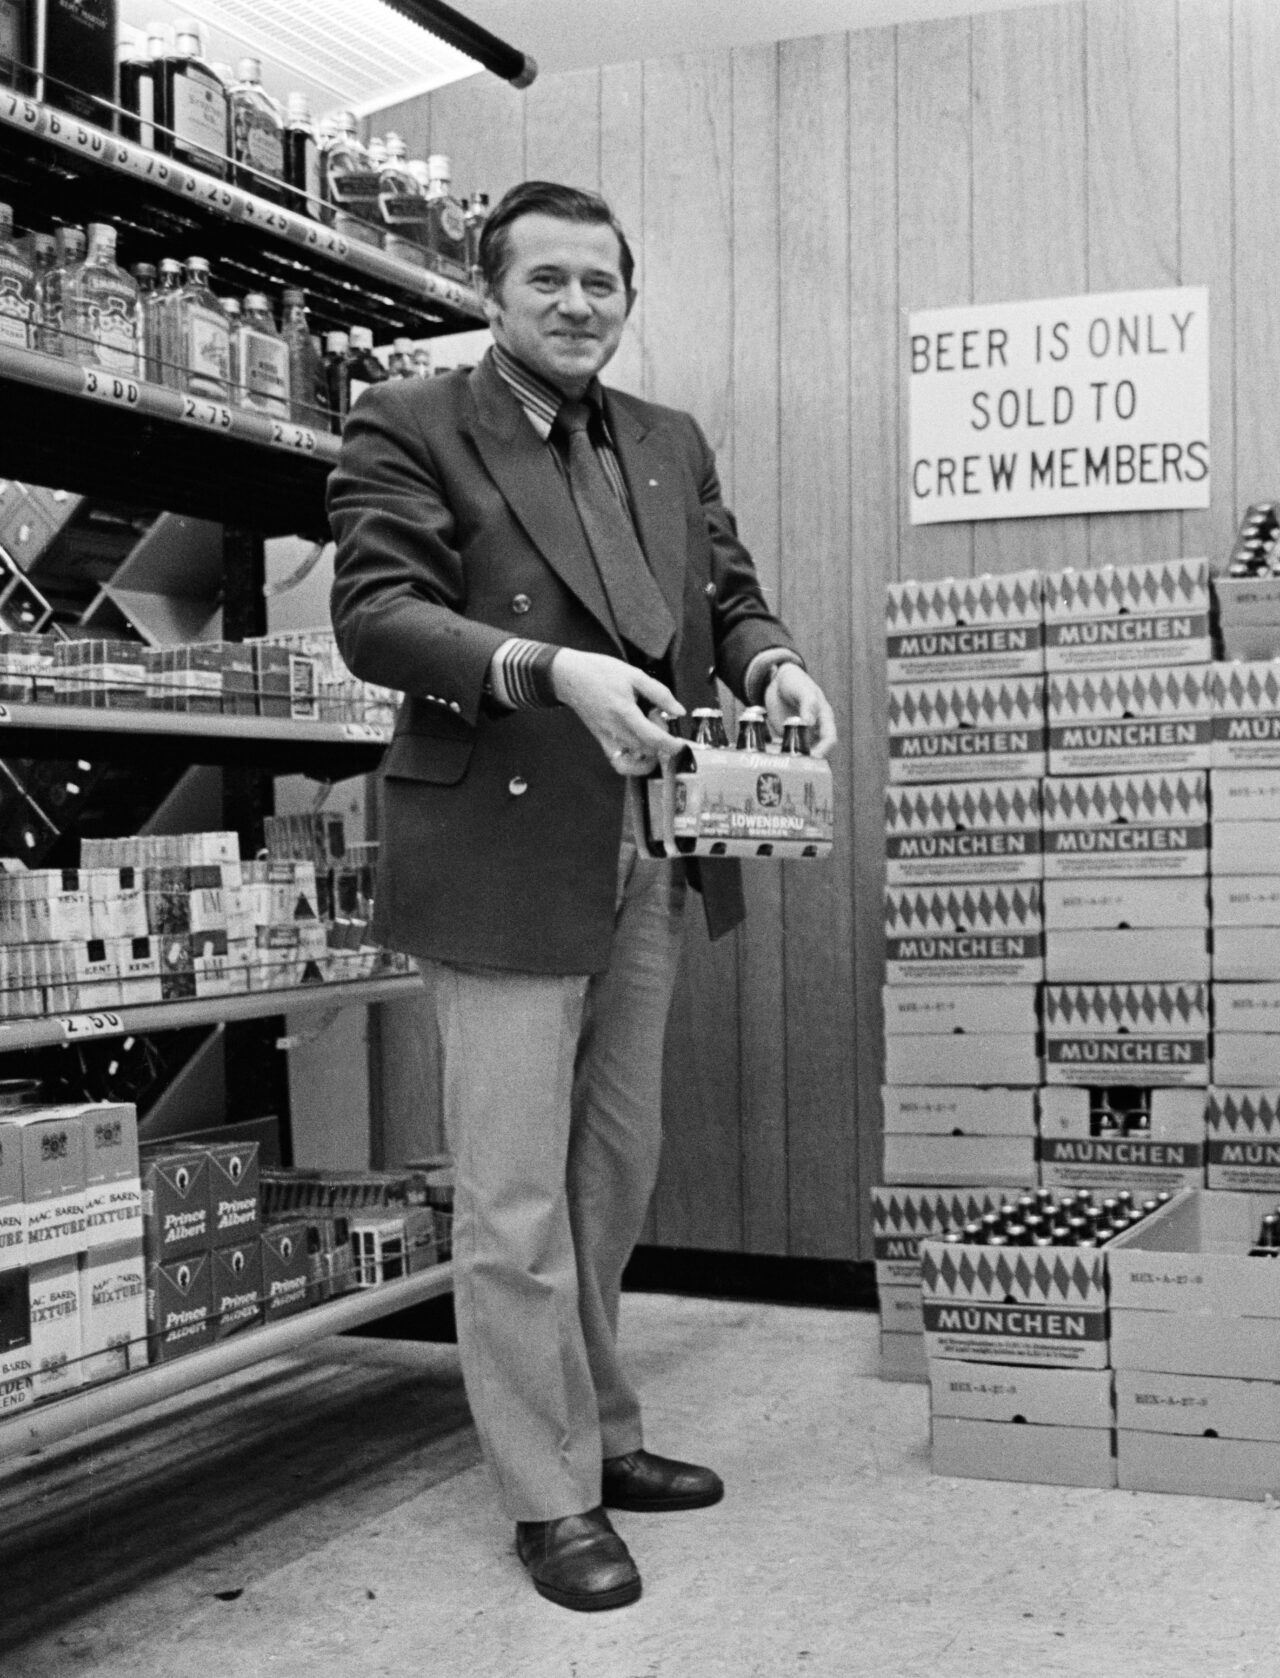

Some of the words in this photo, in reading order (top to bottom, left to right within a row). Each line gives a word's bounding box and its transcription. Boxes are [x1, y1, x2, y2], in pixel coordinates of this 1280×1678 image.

[911, 328, 1008, 374] BEER
[1036, 321, 1070, 364] IS
[1088, 311, 1195, 358] ONLY
[185, 399, 231, 427] 2.75
[970, 386, 1074, 431] SOLD
[1090, 380, 1137, 423] TO
[912, 452, 1018, 499] CREW
[1030, 440, 1209, 491] MEMBERS
[899, 630, 1027, 656] MÜNCHEN
[1058, 618, 1192, 645] MÜNCHEN
[217, 1197, 257, 1216] Prince
[164, 1209, 207, 1230] Prince
[217, 1209, 257, 1229] Albert
[164, 1222, 207, 1244] Albert
[270, 1275, 307, 1296] Prince
[31, 1299, 78, 1323] IXTURE
[220, 1290, 257, 1311] Prince
[165, 1306, 207, 1329] Prince
[937, 1305, 1087, 1338] MÜNCHEN
